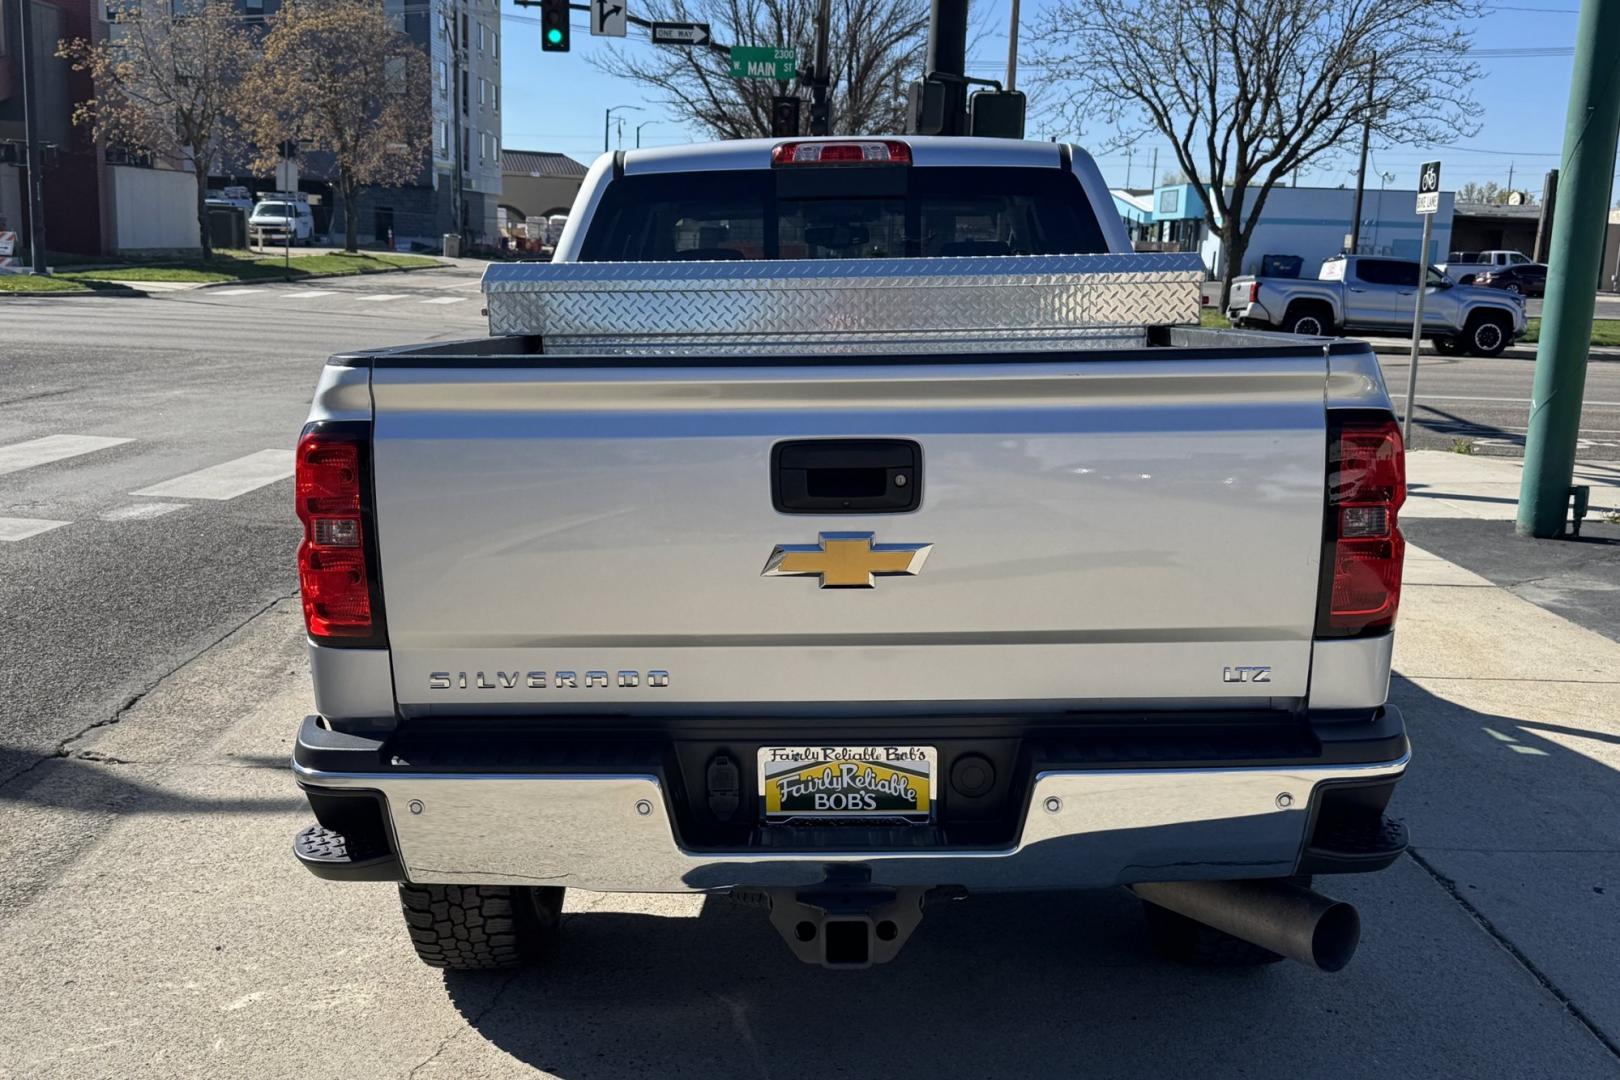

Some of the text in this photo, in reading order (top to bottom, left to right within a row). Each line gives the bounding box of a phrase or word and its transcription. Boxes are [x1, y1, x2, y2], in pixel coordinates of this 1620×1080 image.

[658, 29, 694, 38] ONE WAY
[774, 50, 794, 59] 2300
[747, 61, 776, 77] MAIN
[783, 63, 793, 72] ST
[429, 670, 670, 689] SILVERADO
[1223, 666, 1272, 683] LTZ
[768, 746, 926, 762] Fairly Reliable Bob's
[814, 790, 877, 810] BOB'S
